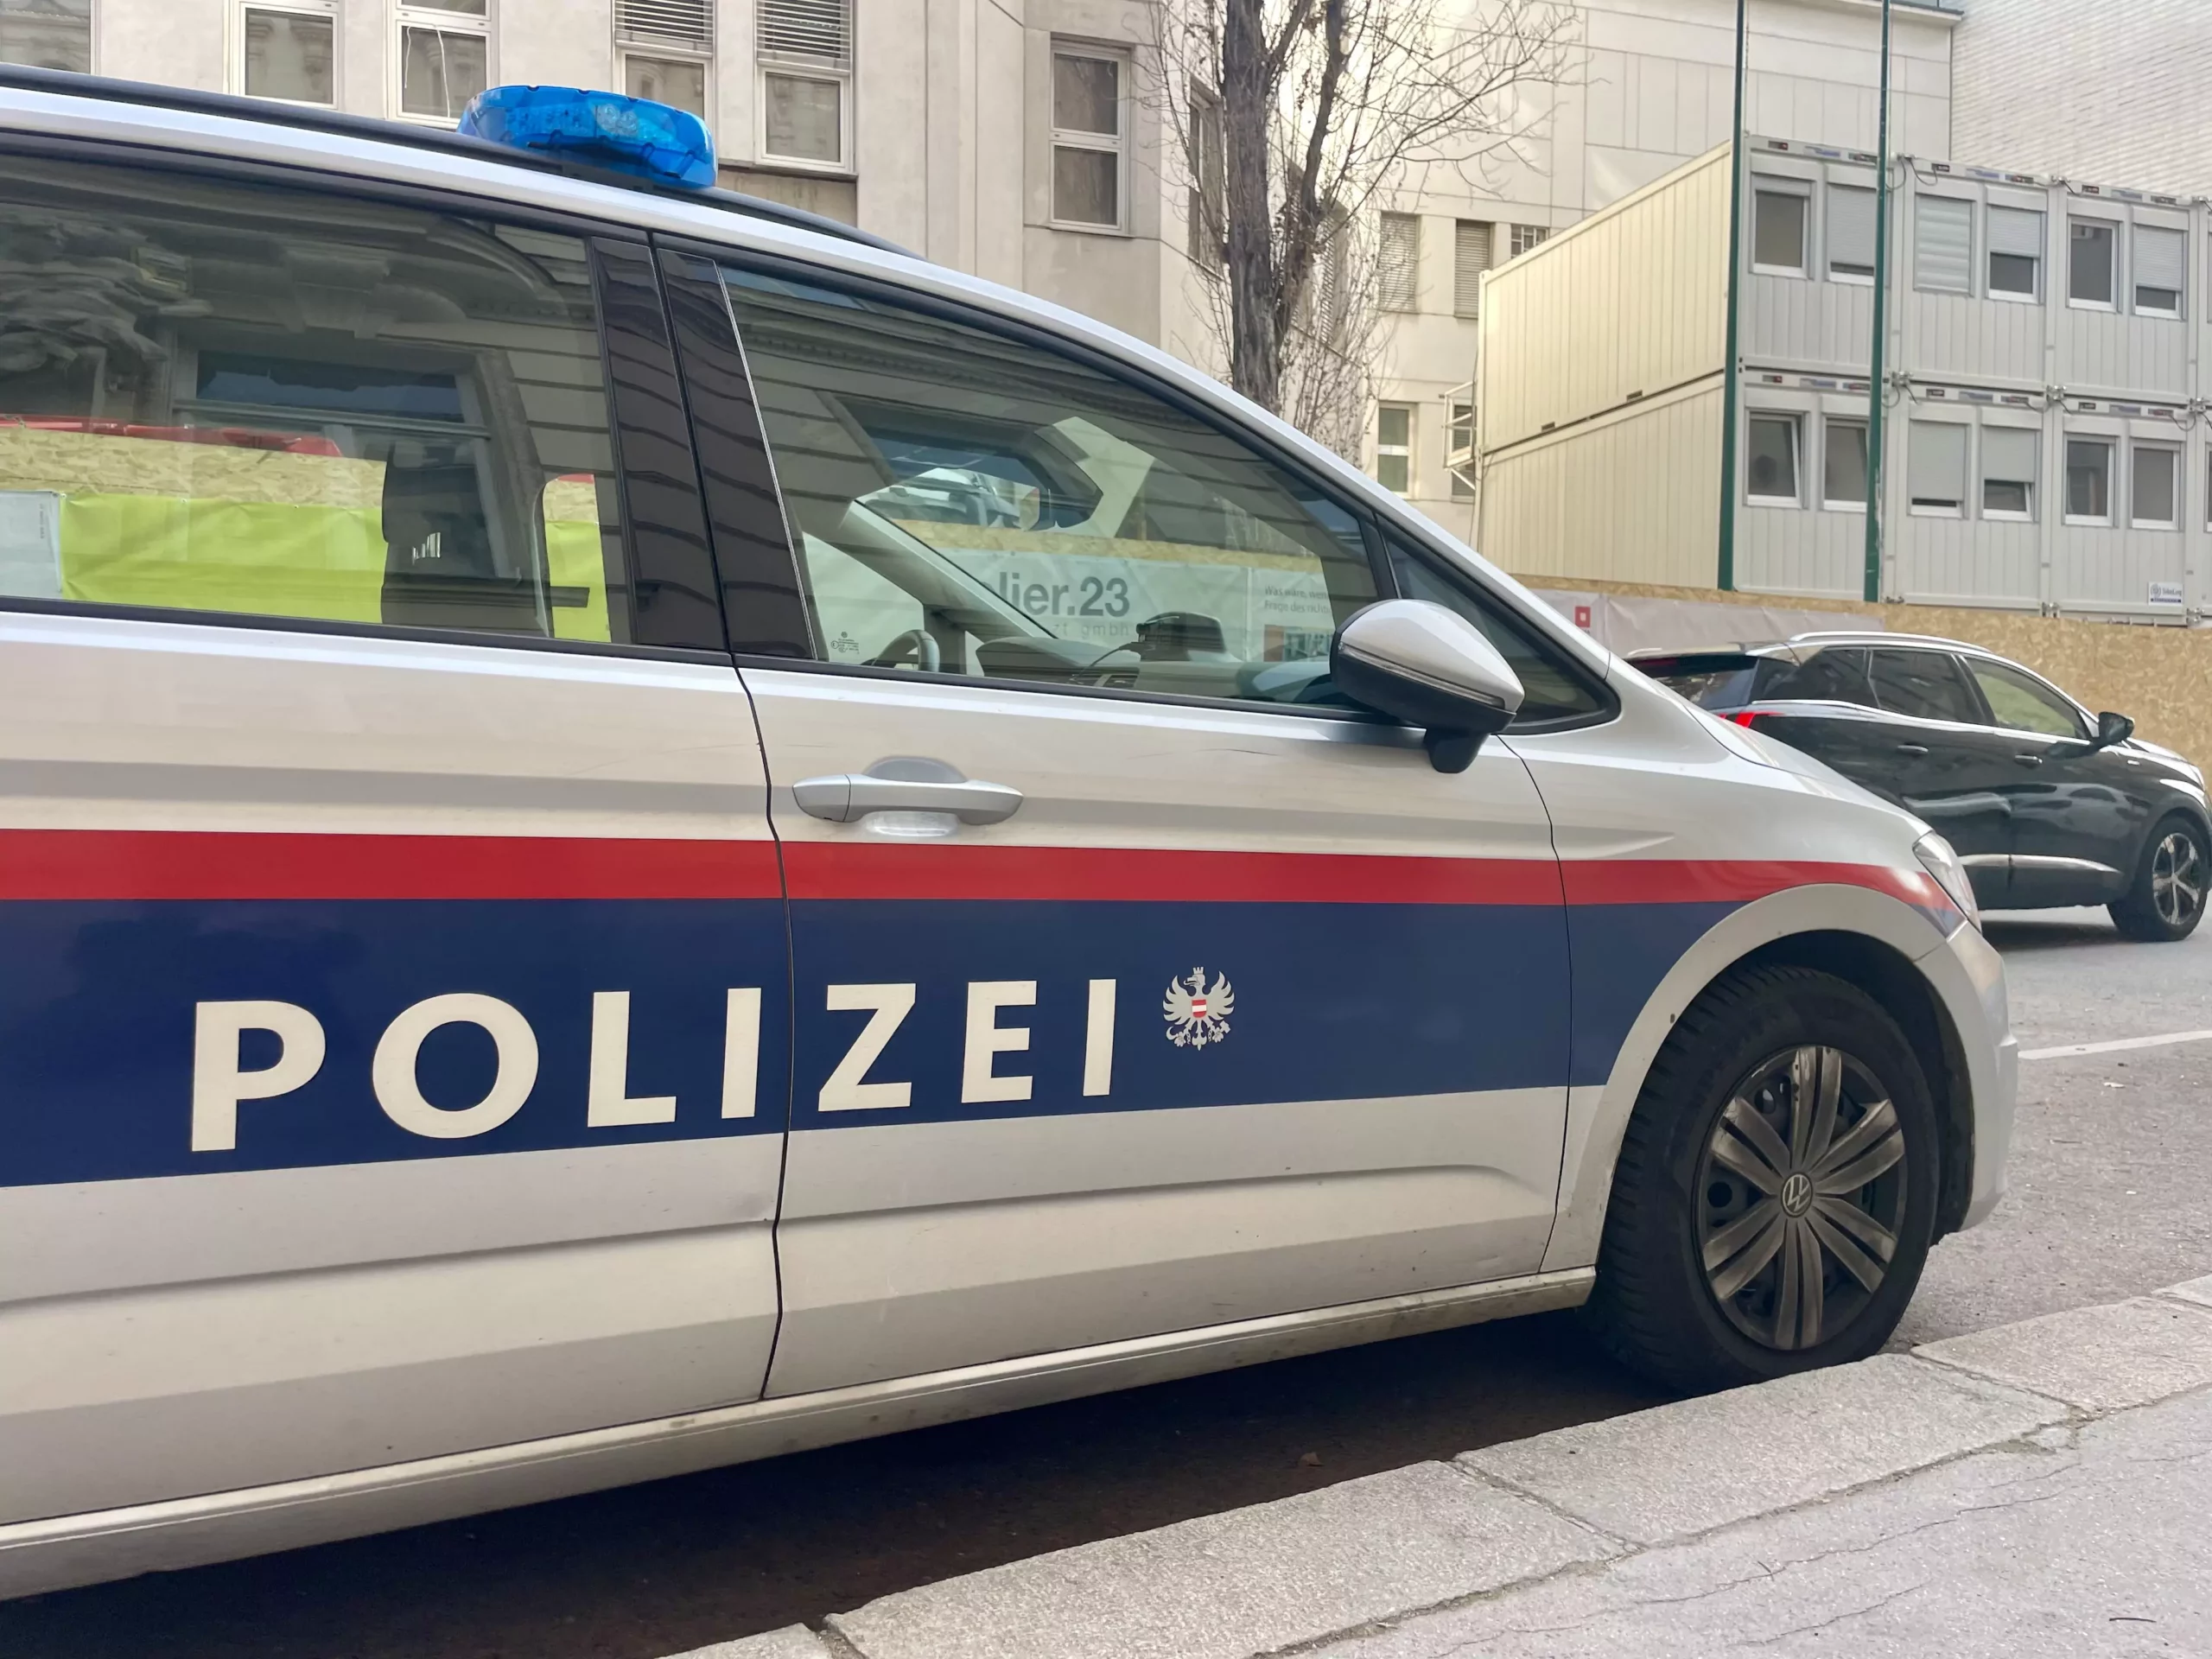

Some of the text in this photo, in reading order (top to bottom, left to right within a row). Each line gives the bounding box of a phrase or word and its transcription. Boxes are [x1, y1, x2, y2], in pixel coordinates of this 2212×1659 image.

[982, 571, 1130, 617] lier.23
[1081, 622, 1129, 639] gmbh
[191, 977, 1117, 1153] POLIZEI
